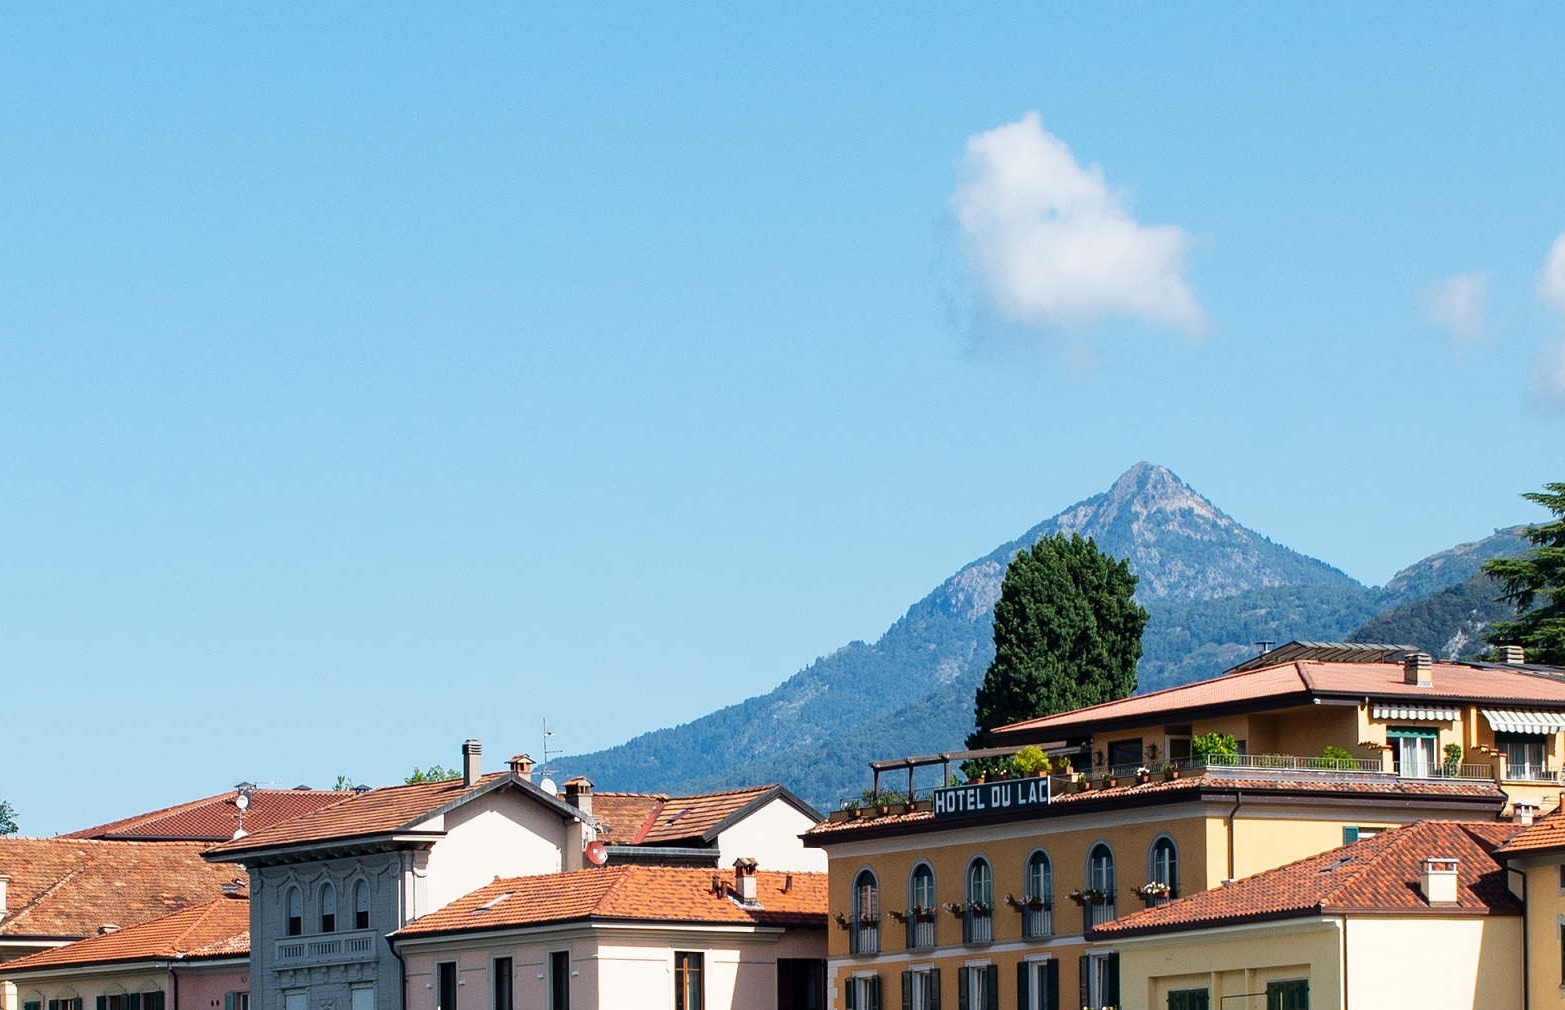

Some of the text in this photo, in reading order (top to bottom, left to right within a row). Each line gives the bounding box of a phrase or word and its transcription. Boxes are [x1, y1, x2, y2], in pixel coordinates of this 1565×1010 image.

[935, 780, 1047, 813] HOTEL DU LAC
